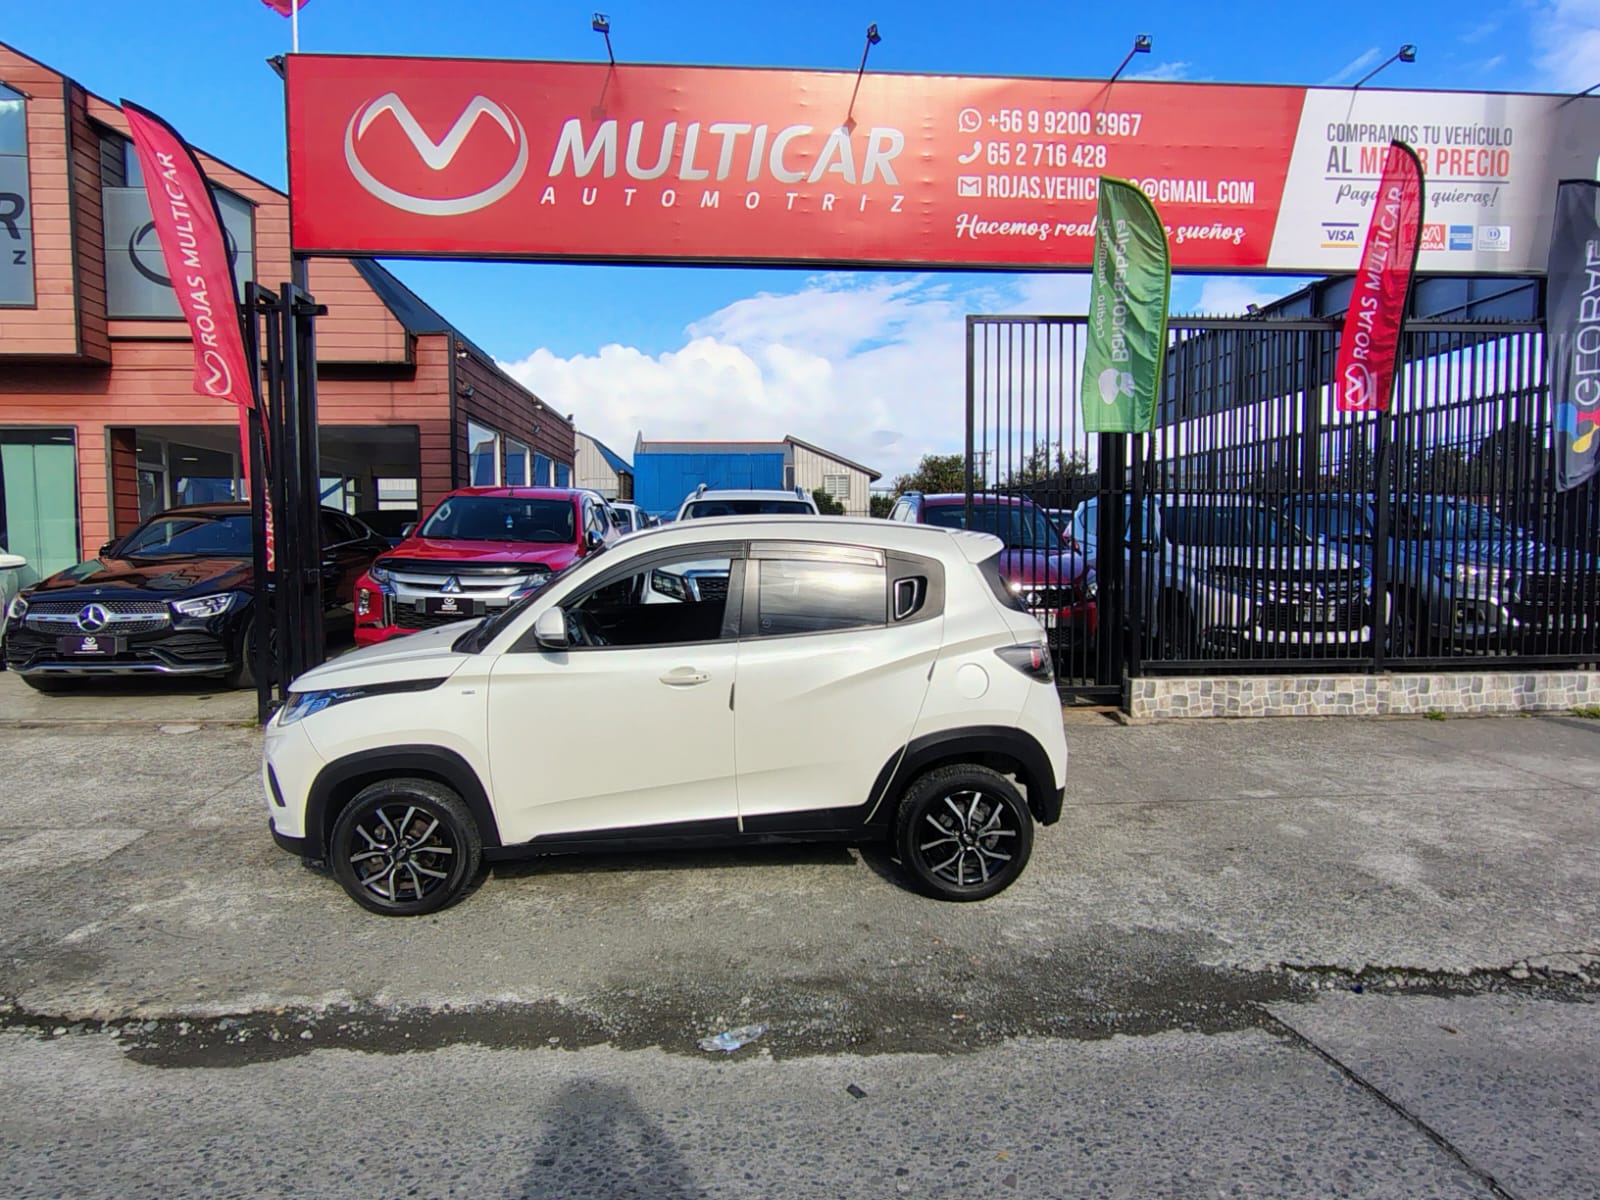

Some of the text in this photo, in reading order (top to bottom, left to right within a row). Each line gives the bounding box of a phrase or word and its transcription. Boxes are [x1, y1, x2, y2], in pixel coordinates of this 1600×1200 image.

[988, 110, 1142, 136] +56 9 9200 3967
[1327, 122, 1513, 146] COMPRAMOS TU VEHÍCULO
[548, 118, 905, 186] MULTICAR
[987, 141, 1107, 168] 65 2 716 428
[1326, 145, 1353, 173] AL
[1435, 148, 1510, 177] PRECIO
[539, 186, 905, 213] AUTOMOTRIZ
[1431, 186, 1500, 208] quieras!
[955, 213, 1052, 241] Hacemos
[1176, 222, 1246, 244] sueños
[1326, 230, 1355, 241] VISA
[1364, 186, 1404, 291] MULTICAR
[157, 151, 219, 348] ROJAS MULTICAR
[1353, 297, 1377, 360] ROJAS
